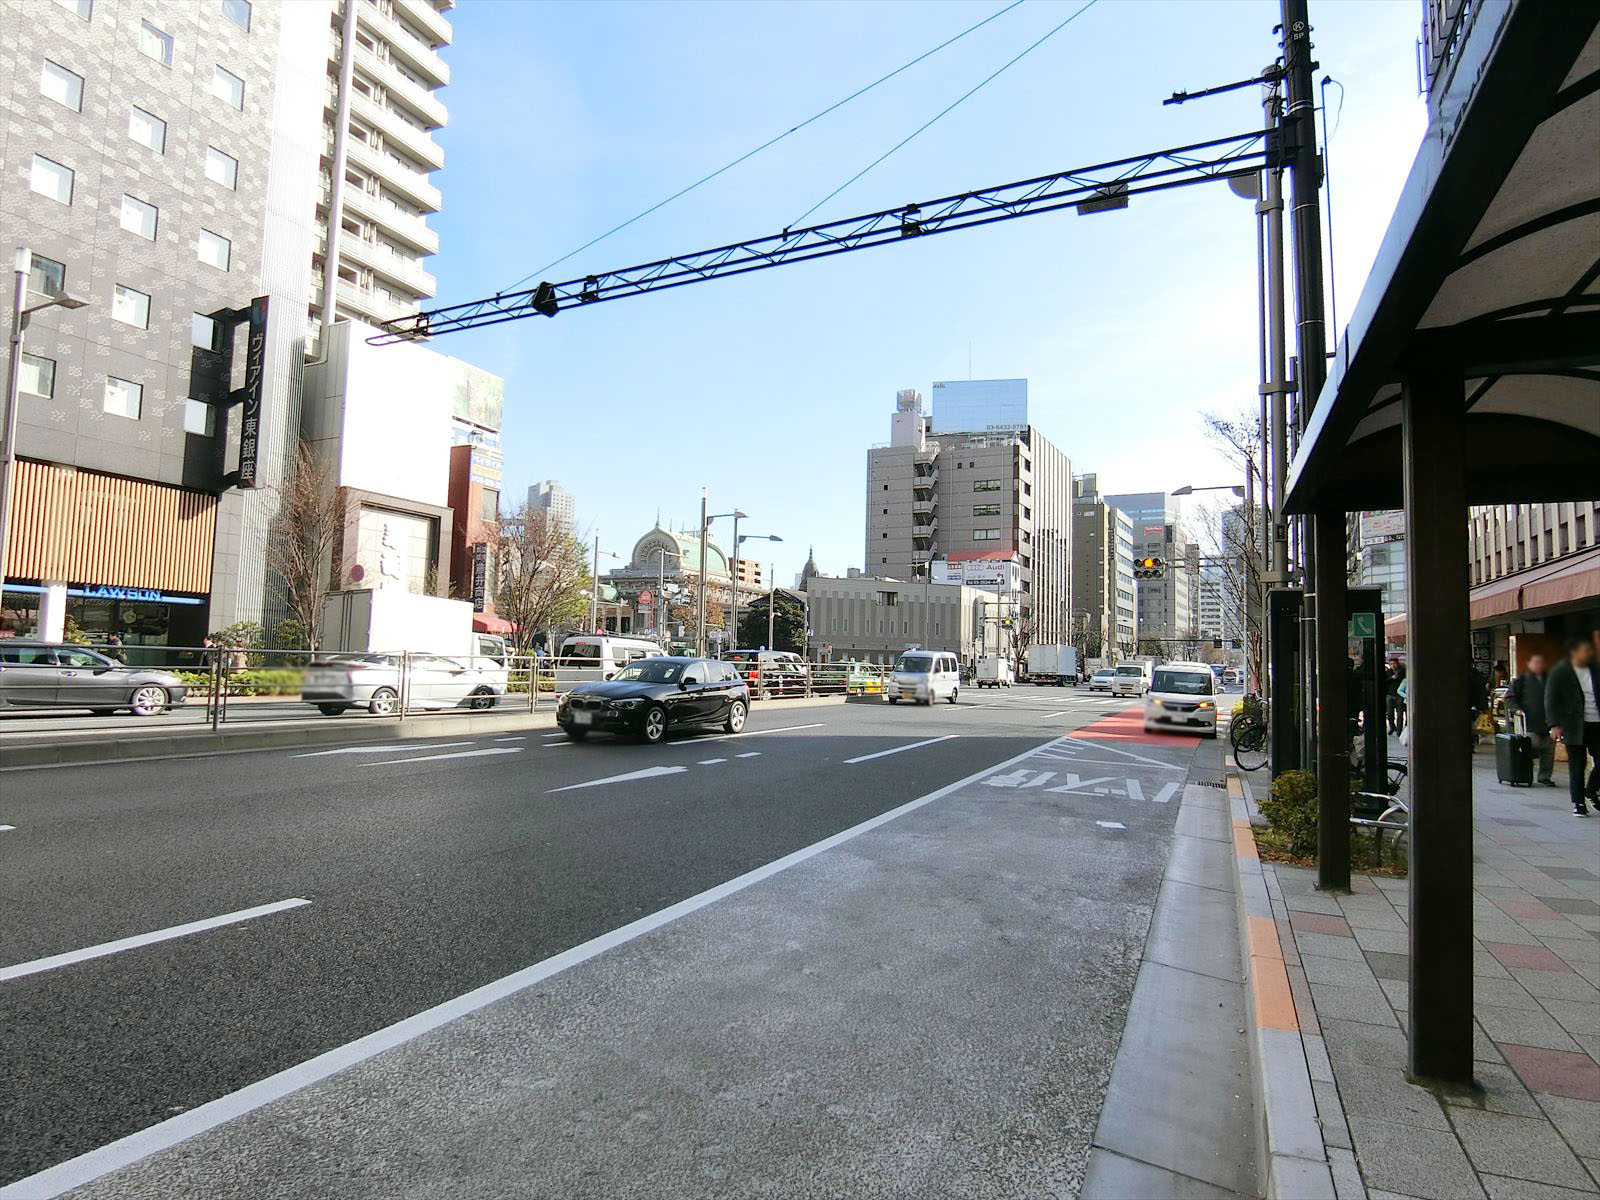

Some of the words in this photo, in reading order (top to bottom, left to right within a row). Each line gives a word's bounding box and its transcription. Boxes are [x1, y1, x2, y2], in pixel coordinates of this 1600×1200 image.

[242, 333, 264, 480] ヴィアイン東銀座
[83, 585, 162, 602] LAWSON
[981, 769, 1180, 803] バス停
